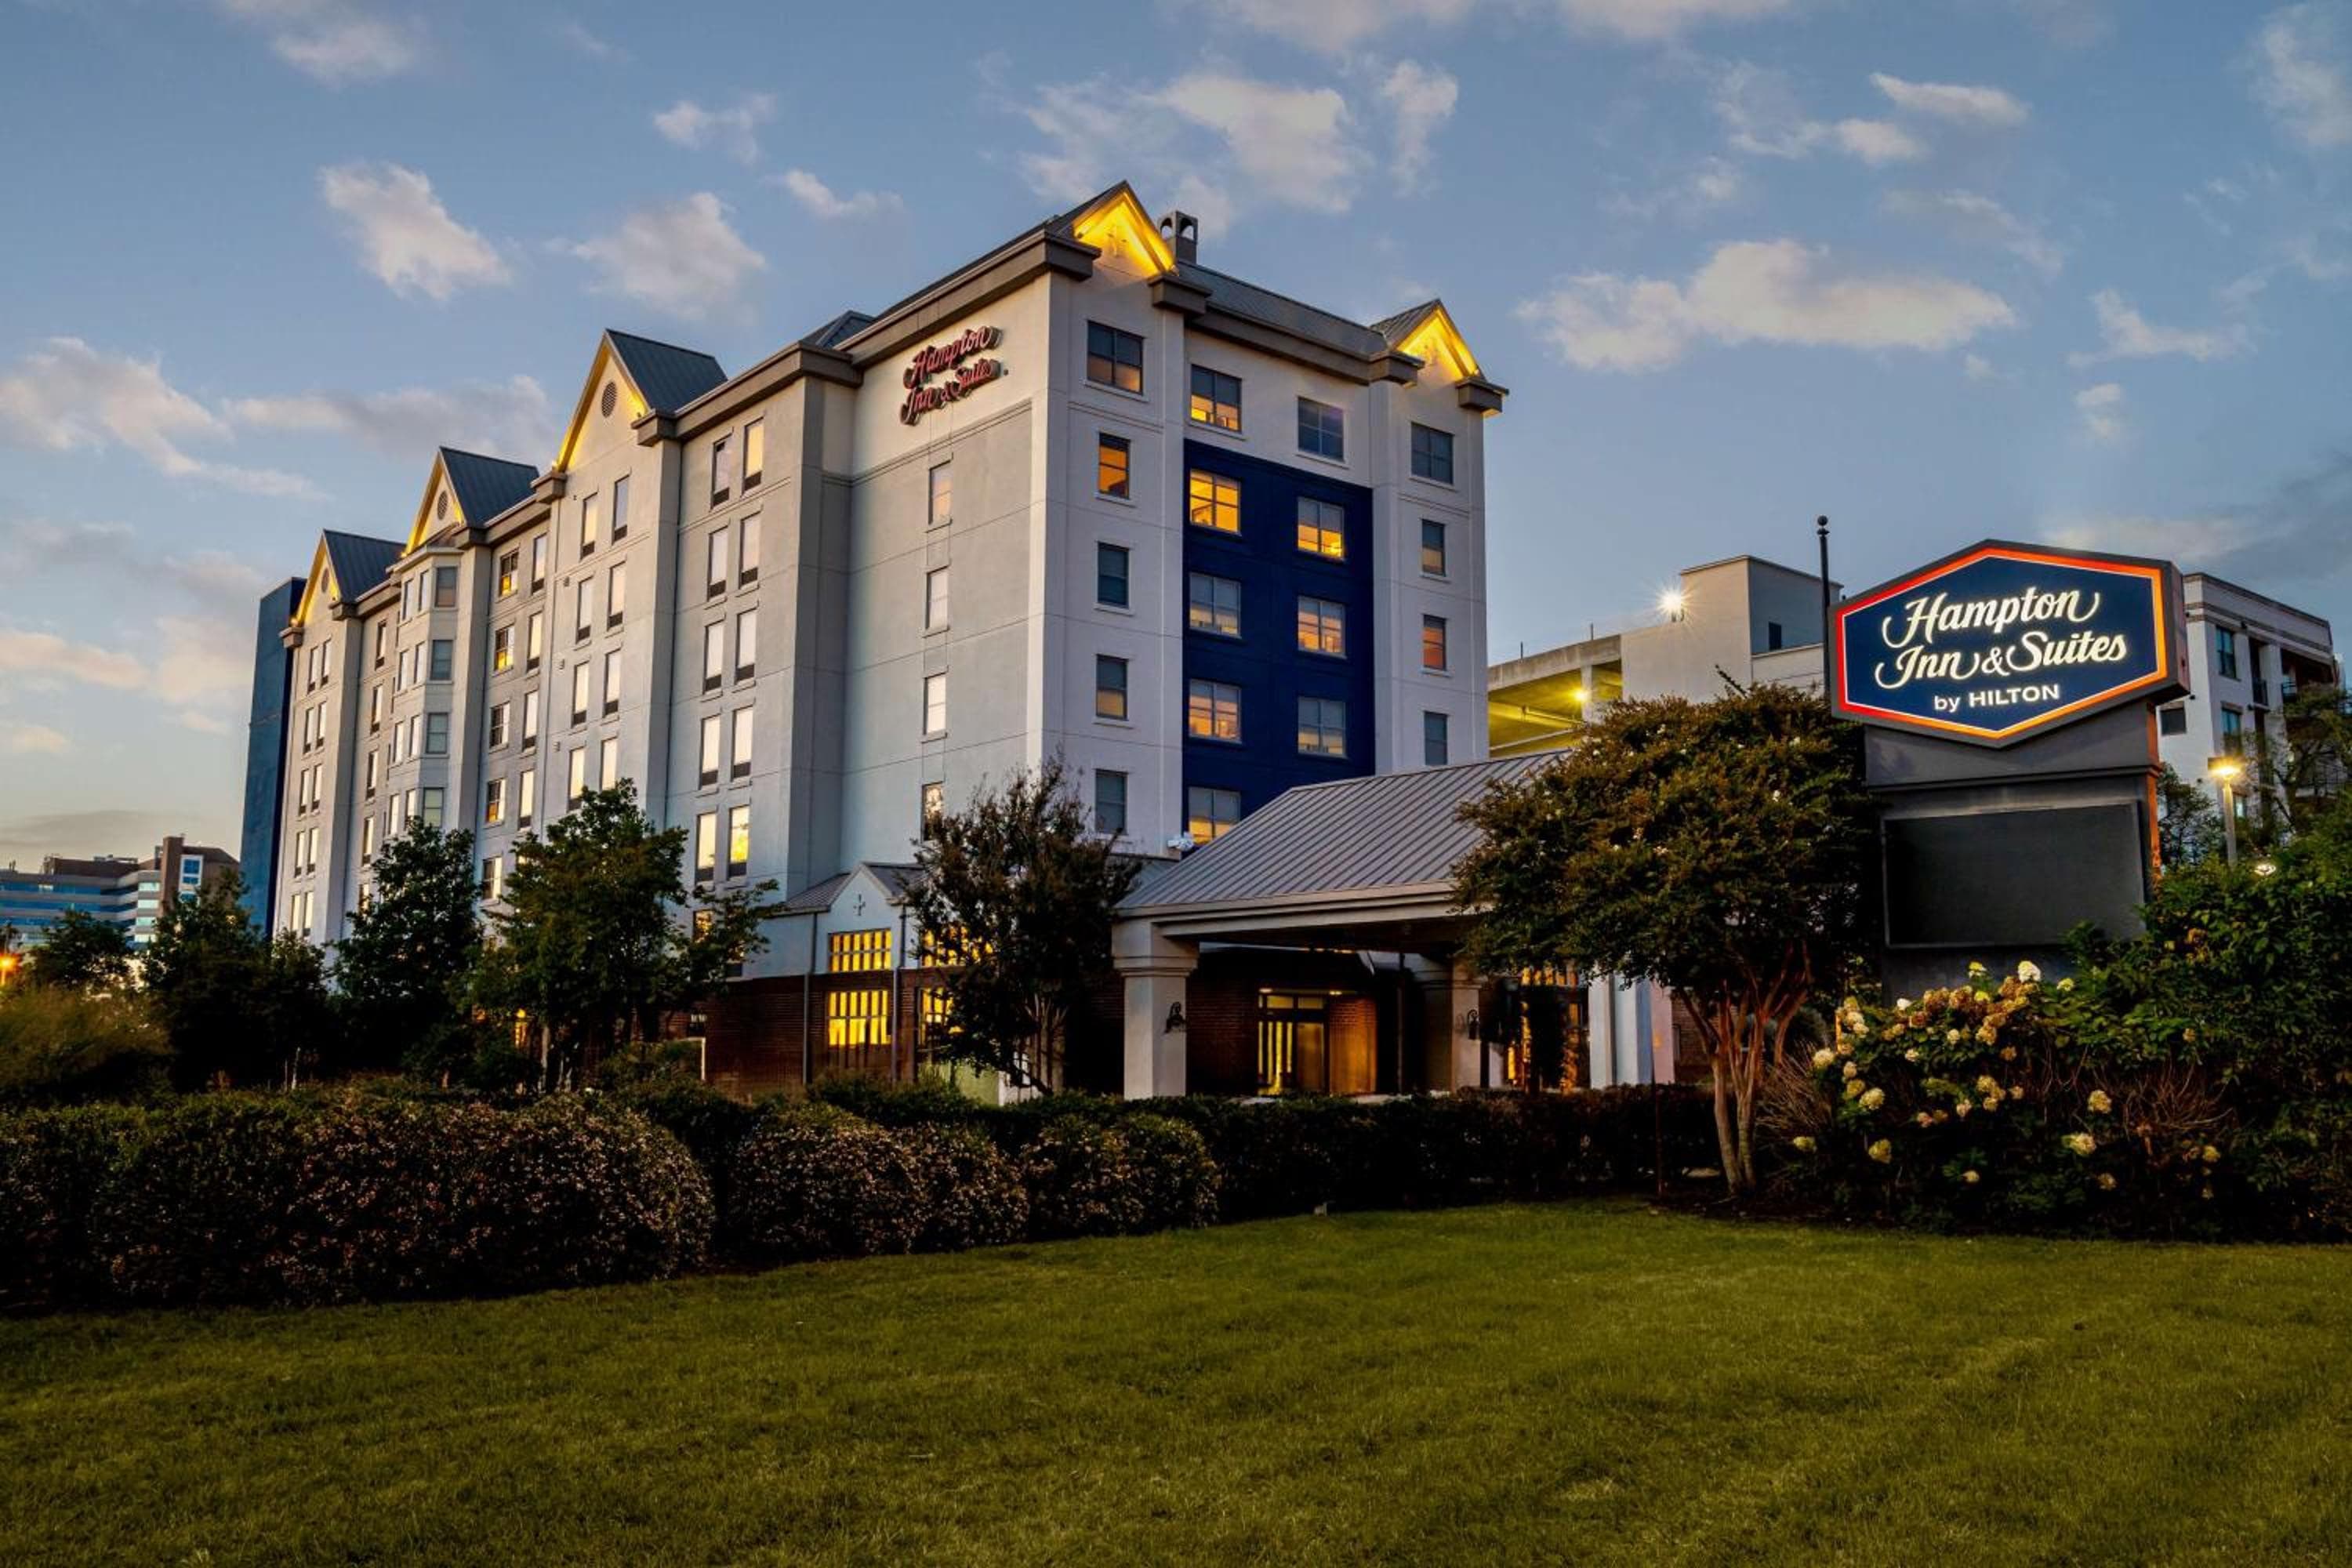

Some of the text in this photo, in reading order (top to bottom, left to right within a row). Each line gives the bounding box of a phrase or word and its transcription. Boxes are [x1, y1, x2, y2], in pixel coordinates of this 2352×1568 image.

[903, 326, 1003, 389] Hampton
[901, 387, 943, 426] Inn
[950, 358, 1003, 400] Suites
[1882, 586, 2100, 648] Hampton
[1875, 630, 2127, 689] Inn & Suites
[1934, 684, 2060, 713] by HILTON
